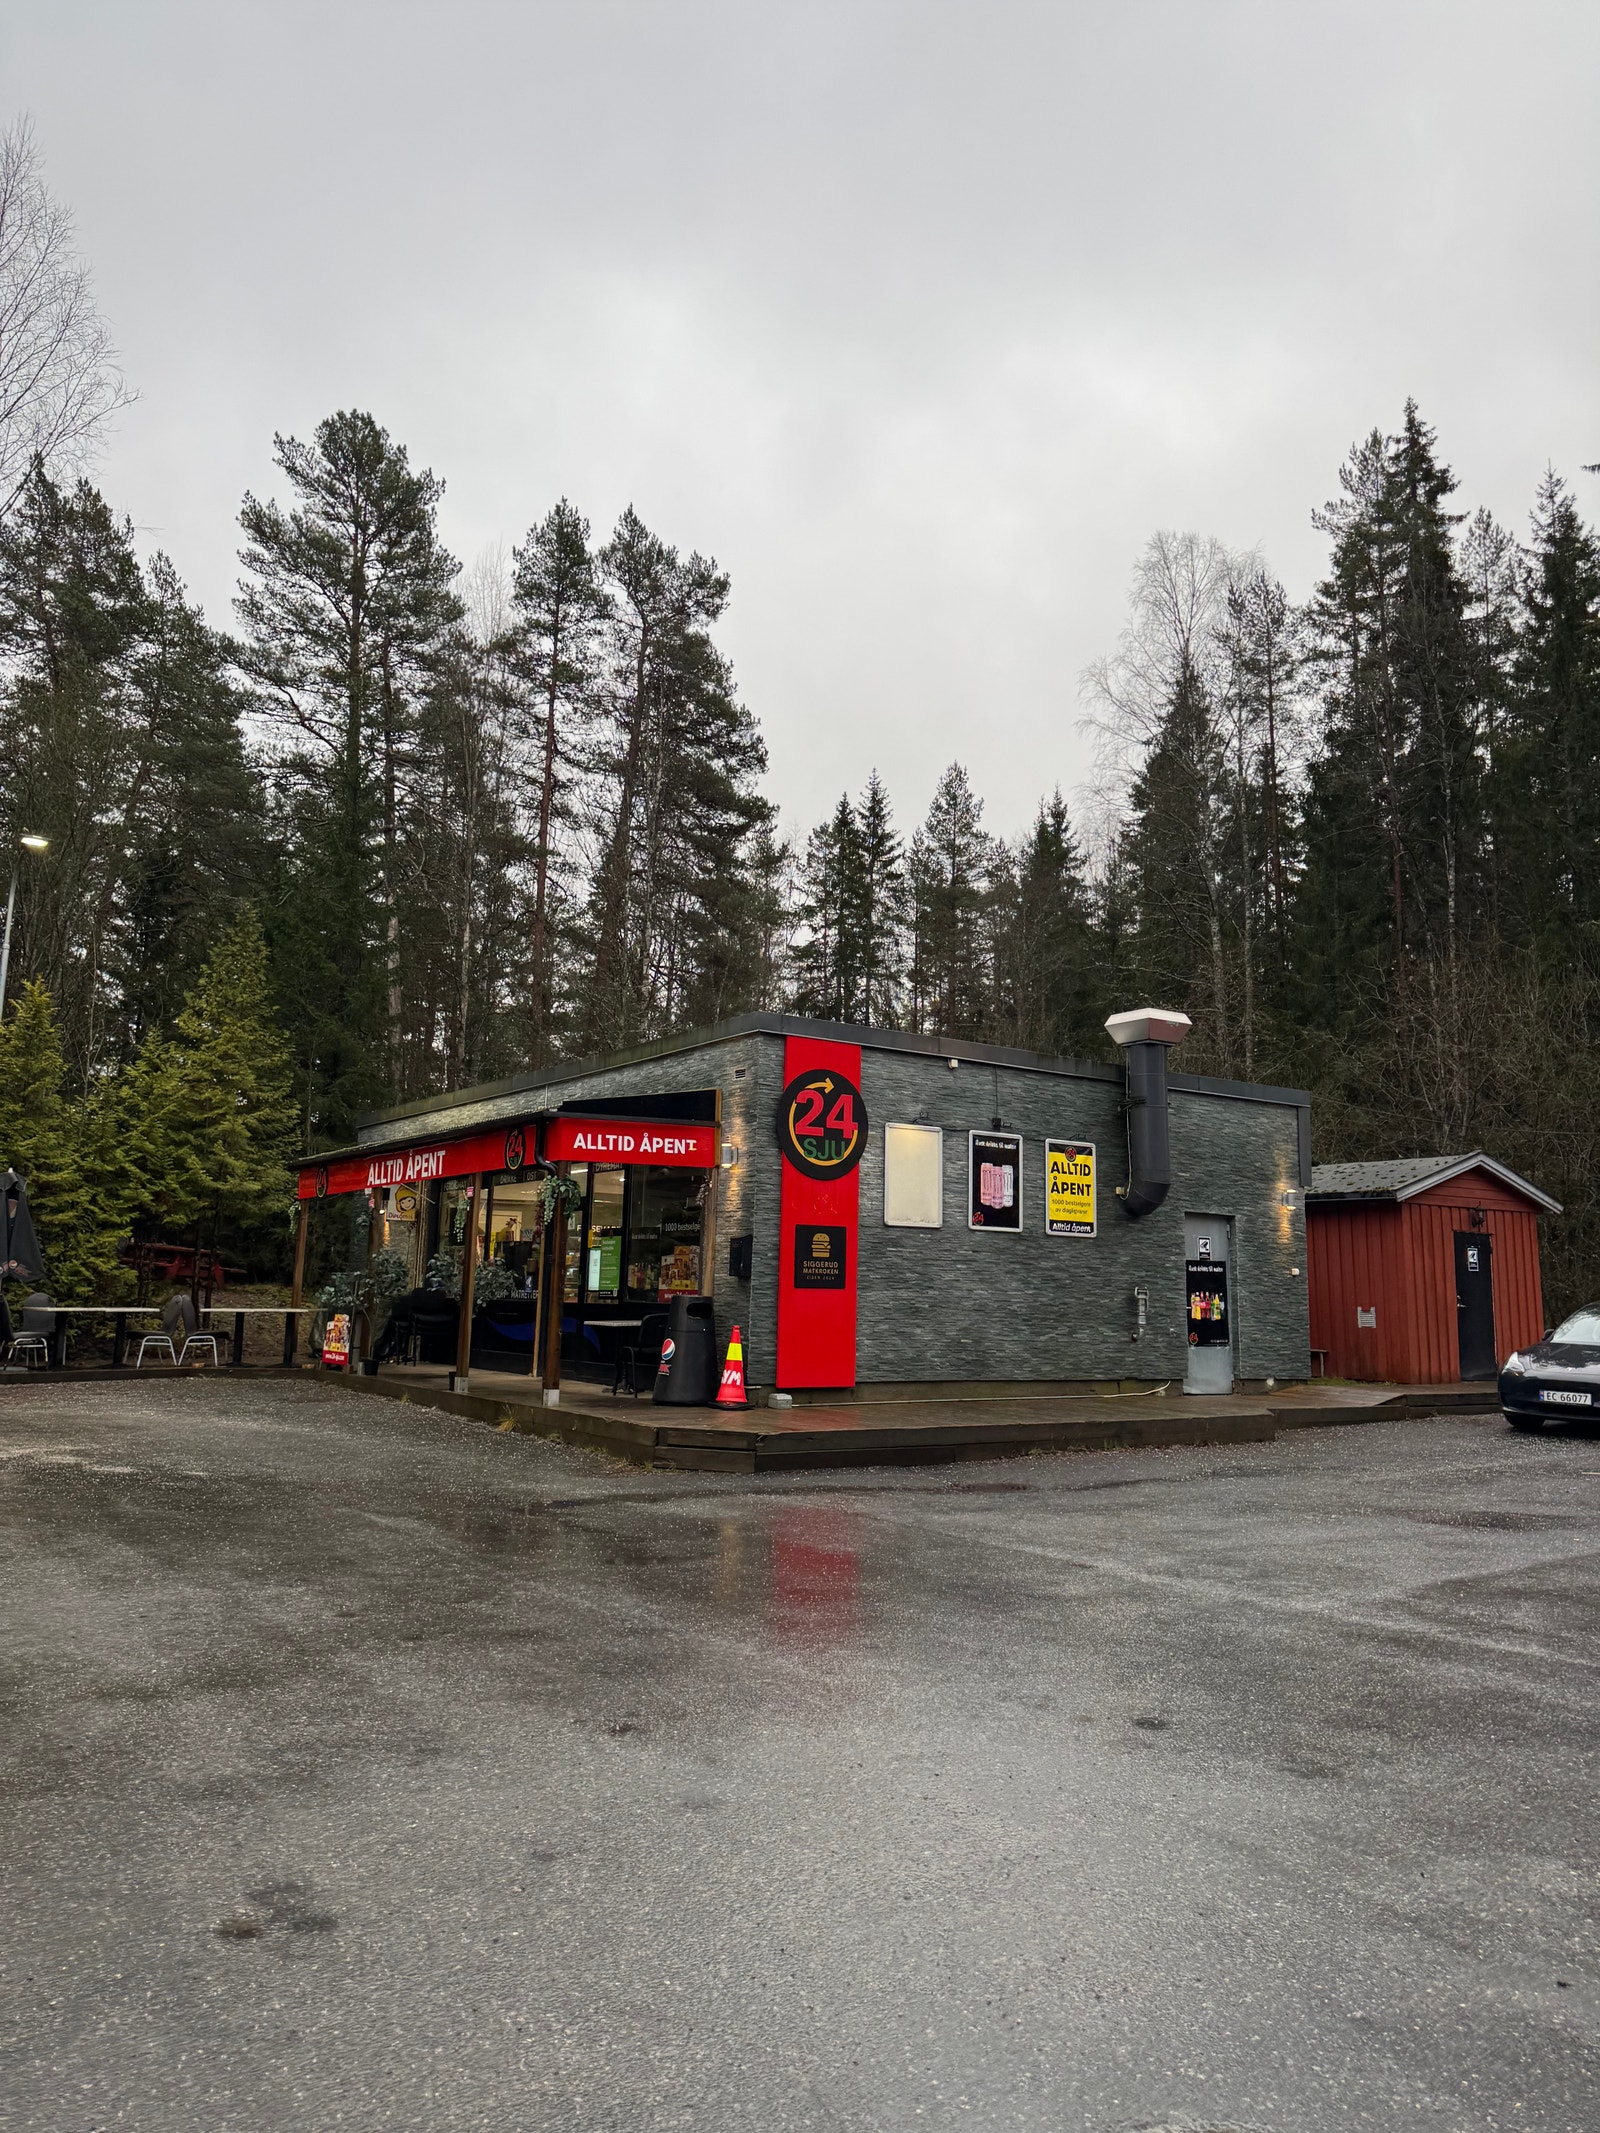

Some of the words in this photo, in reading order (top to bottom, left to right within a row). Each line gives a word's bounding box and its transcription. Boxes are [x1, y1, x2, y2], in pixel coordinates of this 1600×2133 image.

[795, 1089, 858, 1139] 24
[508, 1134, 523, 1157] 24
[573, 1133, 635, 1152] ALLTID
[639, 1132, 697, 1154] ÅPENT
[803, 1137, 846, 1160] SJU
[367, 1158, 403, 1186] ALLTID
[405, 1149, 446, 1181] ÅPENT
[1050, 1161, 1091, 1177] ALLTID
[1050, 1175, 1092, 1197] ÅPENT
[973, 1212, 984, 1222] 24
[665, 1222, 677, 1232] 1000
[1052, 1222, 1070, 1232] Alltid
[1071, 1222, 1091, 1234] åpent
[803, 1260, 839, 1268] SIGGERUD
[1546, 1391, 1557, 1401] EC
[1560, 1393, 1588, 1403] 66077
